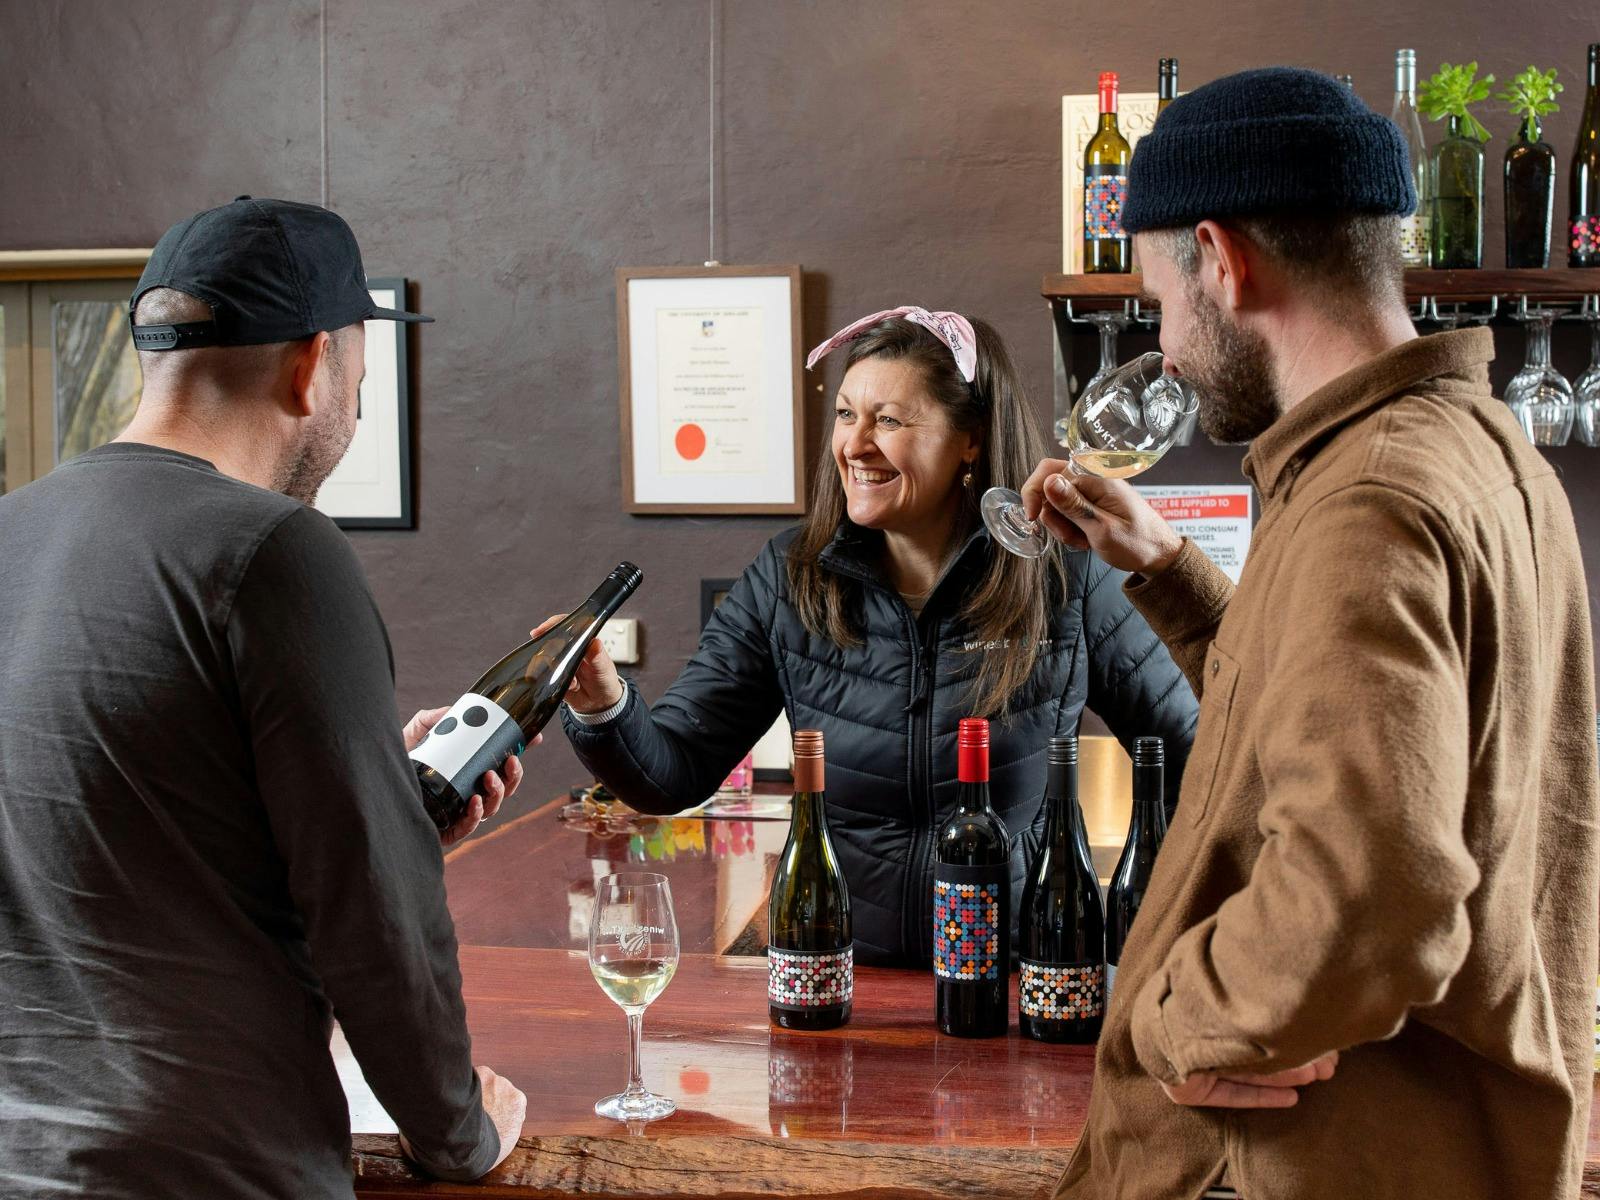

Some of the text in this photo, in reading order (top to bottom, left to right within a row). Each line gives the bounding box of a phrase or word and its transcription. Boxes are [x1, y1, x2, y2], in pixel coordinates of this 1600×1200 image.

[1151, 498, 1230, 508] NOT BE SUPPLIED TO
[1163, 508, 1189, 517] UNDER
